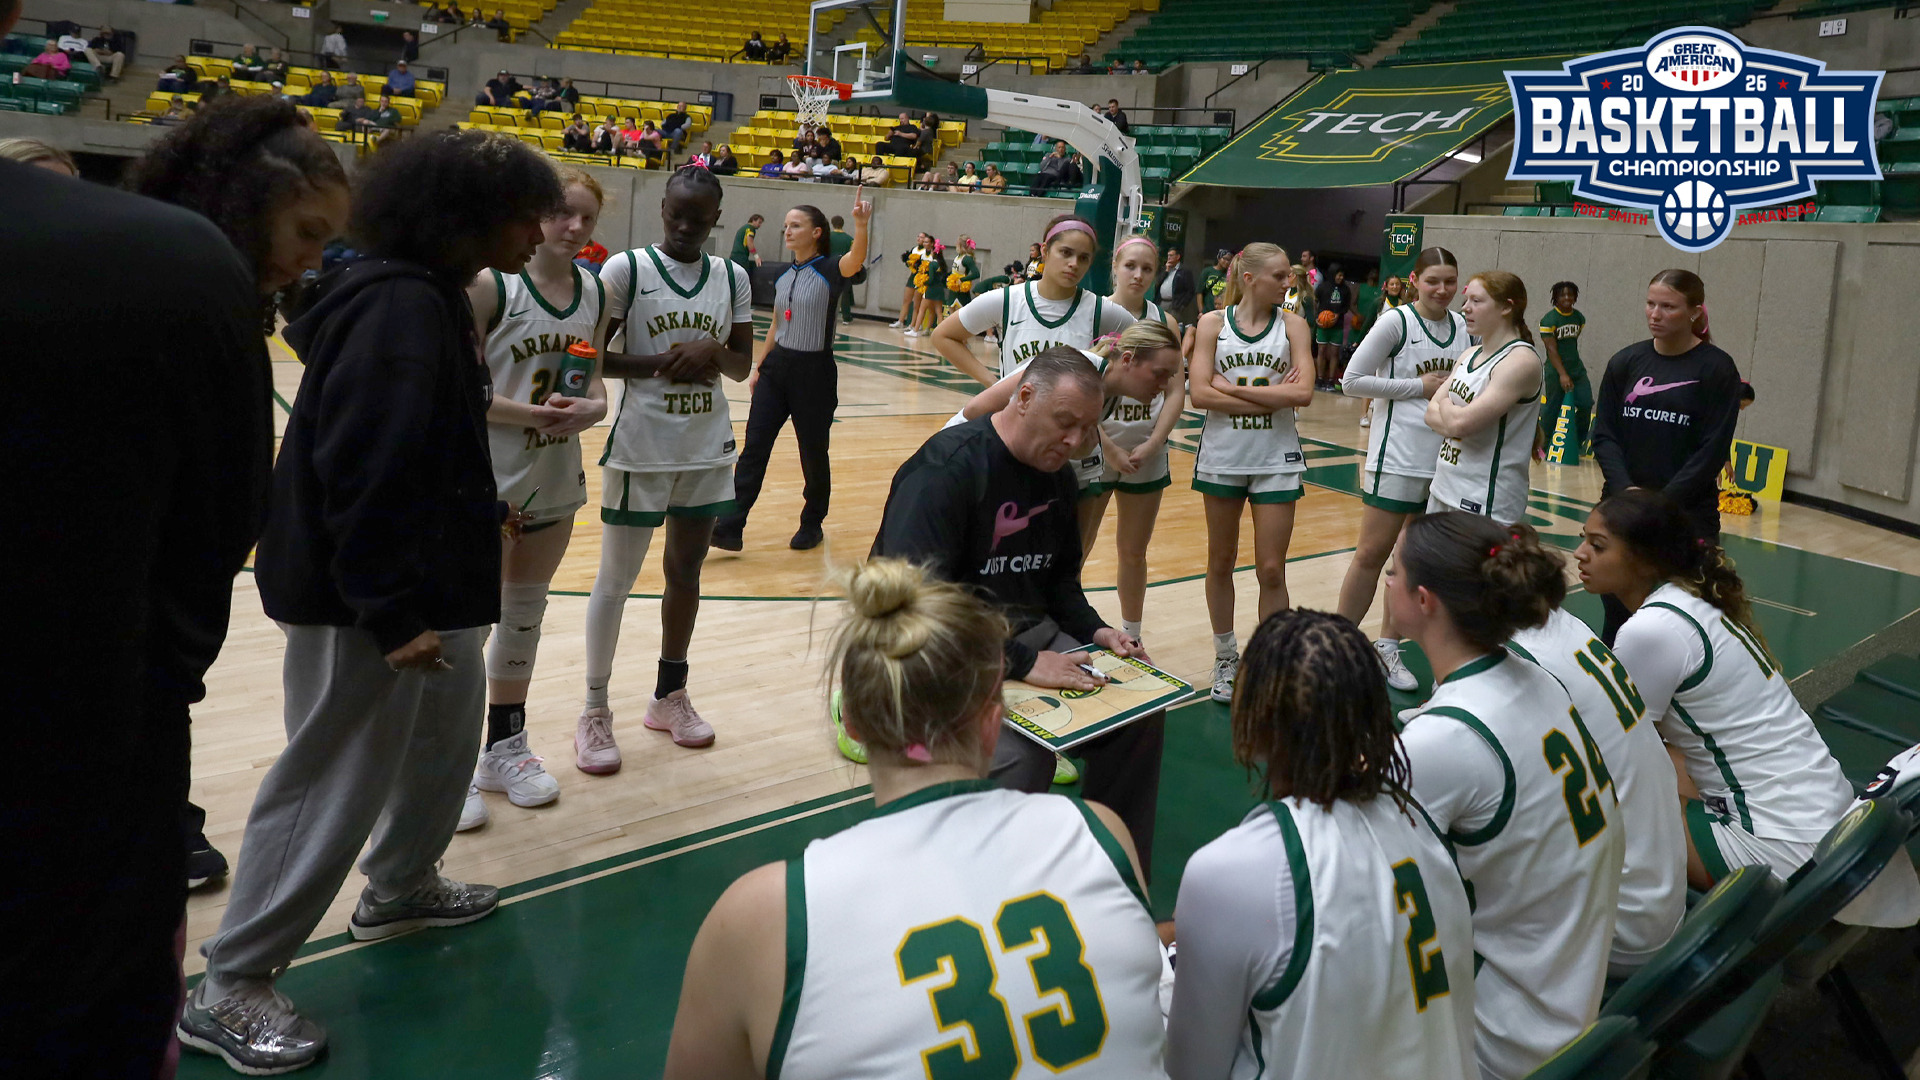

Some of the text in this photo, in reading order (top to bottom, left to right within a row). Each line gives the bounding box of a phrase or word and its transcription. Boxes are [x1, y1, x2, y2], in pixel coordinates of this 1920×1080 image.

[1297, 106, 1476, 134] TECH
[1165, 221, 1181, 232] TECH
[1391, 233, 1413, 244] TECH
[1556, 323, 1581, 340] TECH
[510, 333, 583, 364] ARKAN
[1219, 352, 1288, 375] ARKANSAS
[1415, 357, 1457, 377] ARKAN
[565, 369, 586, 390] G
[663, 391, 713, 415] TECH
[1622, 406, 1642, 418] UST
[1644, 408, 1677, 423] CURE
[1229, 412, 1274, 430] TECH
[1546, 404, 1572, 464] TECH
[1735, 441, 1775, 494] U
[1574, 637, 1647, 734] 12
[1008, 711, 1057, 739] ARKANS
[1541, 704, 1620, 849] 24
[1390, 856, 1451, 1014] 2
[894, 889, 1110, 1080] 33
